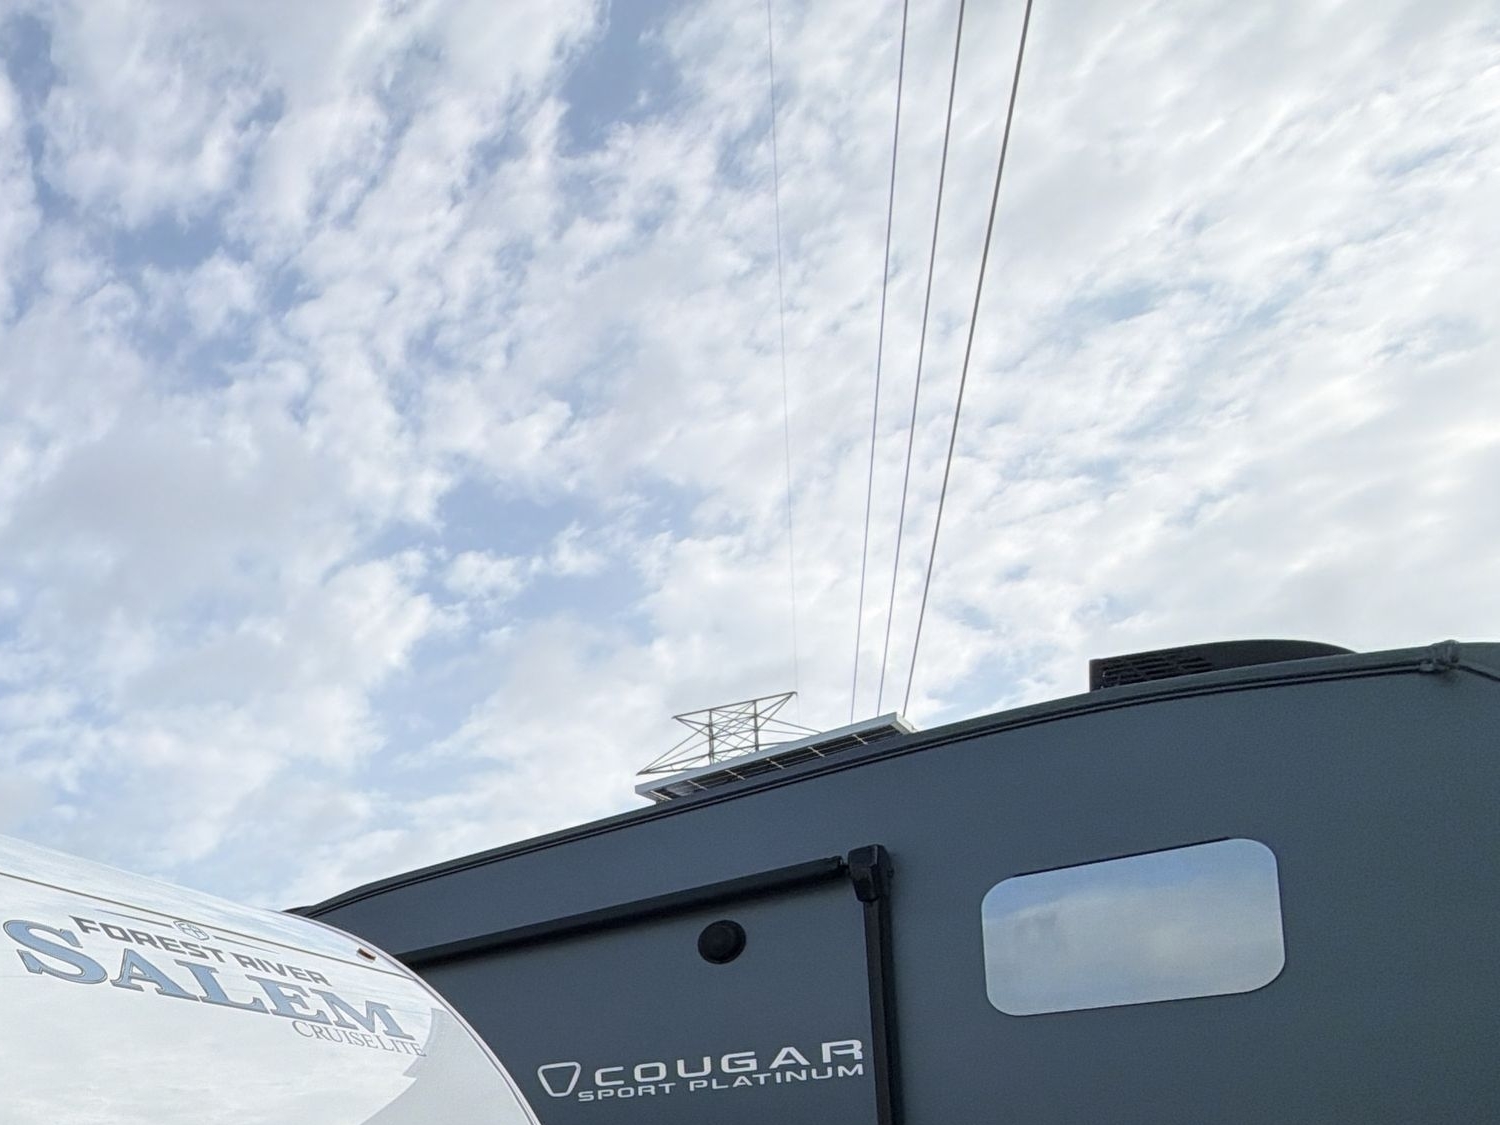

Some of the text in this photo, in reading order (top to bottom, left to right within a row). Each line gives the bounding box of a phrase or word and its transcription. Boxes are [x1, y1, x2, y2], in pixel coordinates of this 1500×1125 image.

[3, 919, 415, 1041] SALEM
[68, 915, 333, 987] FOREST RIVER
[578, 1063, 864, 1102] SPORT PLATINUM
[594, 1039, 863, 1087] COUGAR
